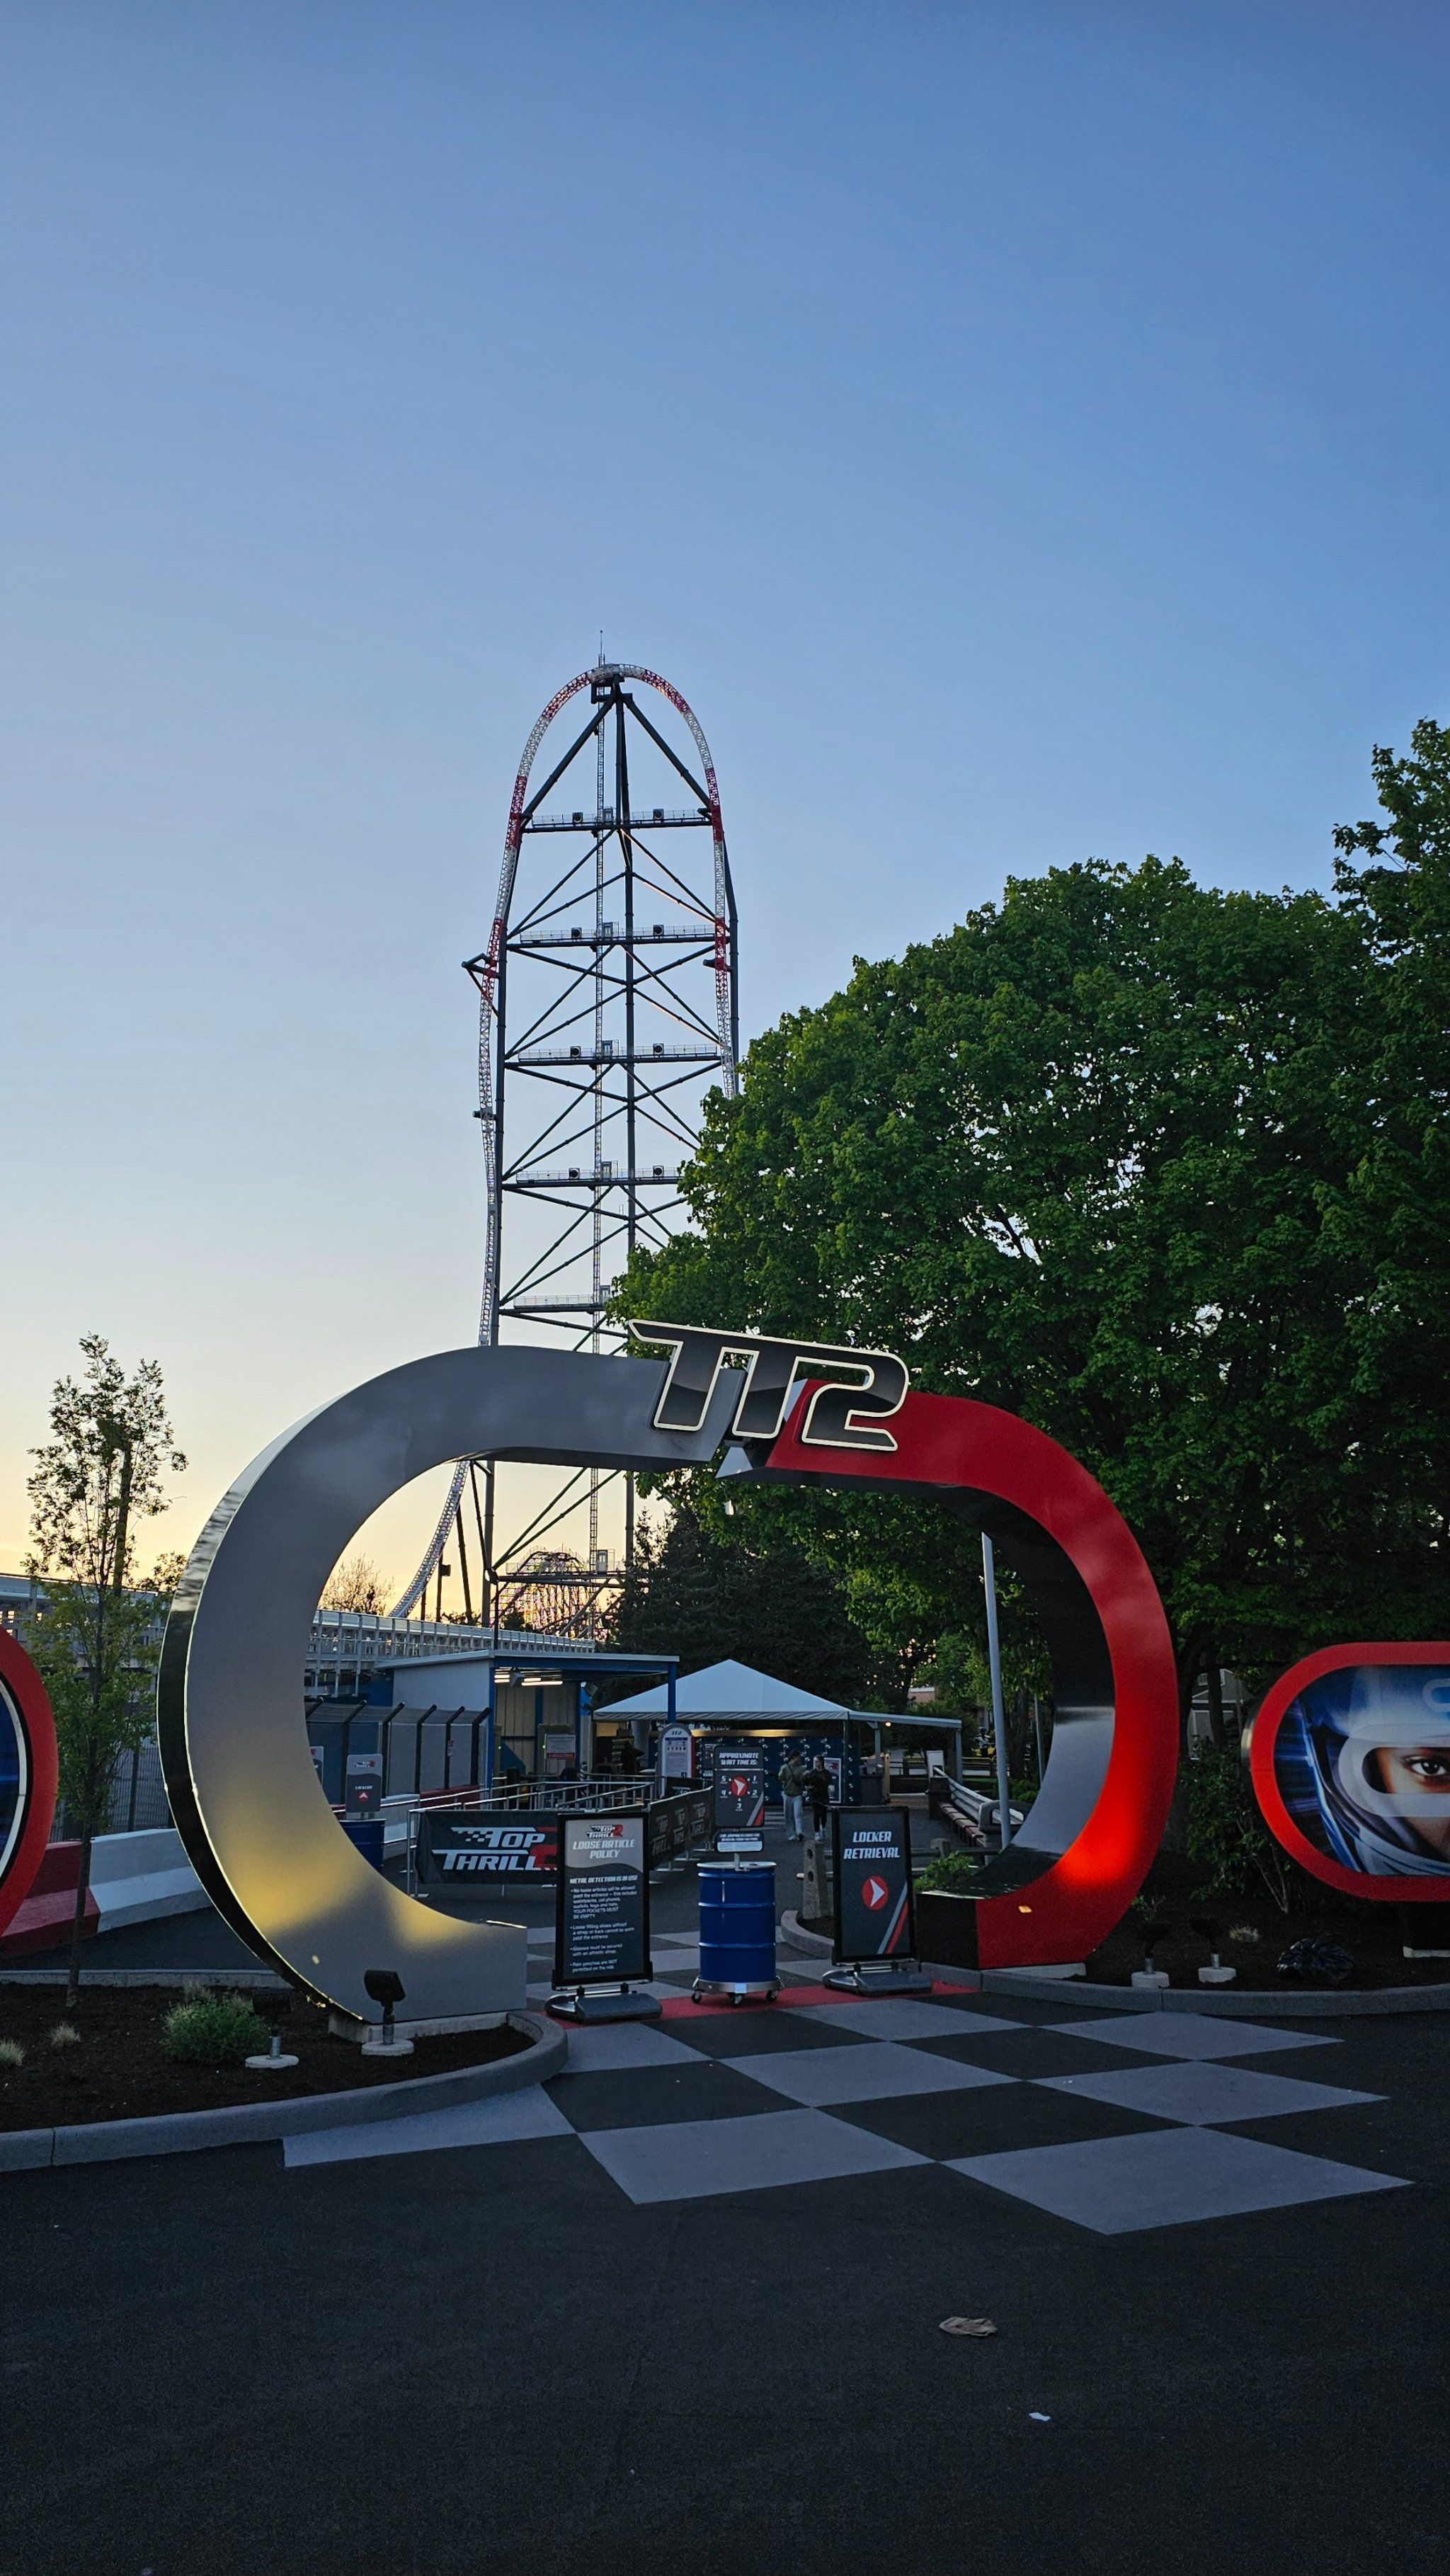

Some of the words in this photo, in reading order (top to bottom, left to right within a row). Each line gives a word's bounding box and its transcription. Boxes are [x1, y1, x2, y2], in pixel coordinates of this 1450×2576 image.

[629, 1318, 909, 1452] TT2
[451, 1827, 545, 1848] TOP
[852, 1831, 891, 1842] LOCKER
[573, 1840, 601, 1850] LOOSE
[602, 1839, 635, 1849] ARTICLE
[589, 1850, 620, 1859] POLICY
[843, 1847, 900, 1859] RETRIEVAL
[431, 1850, 542, 1871] THRILL
